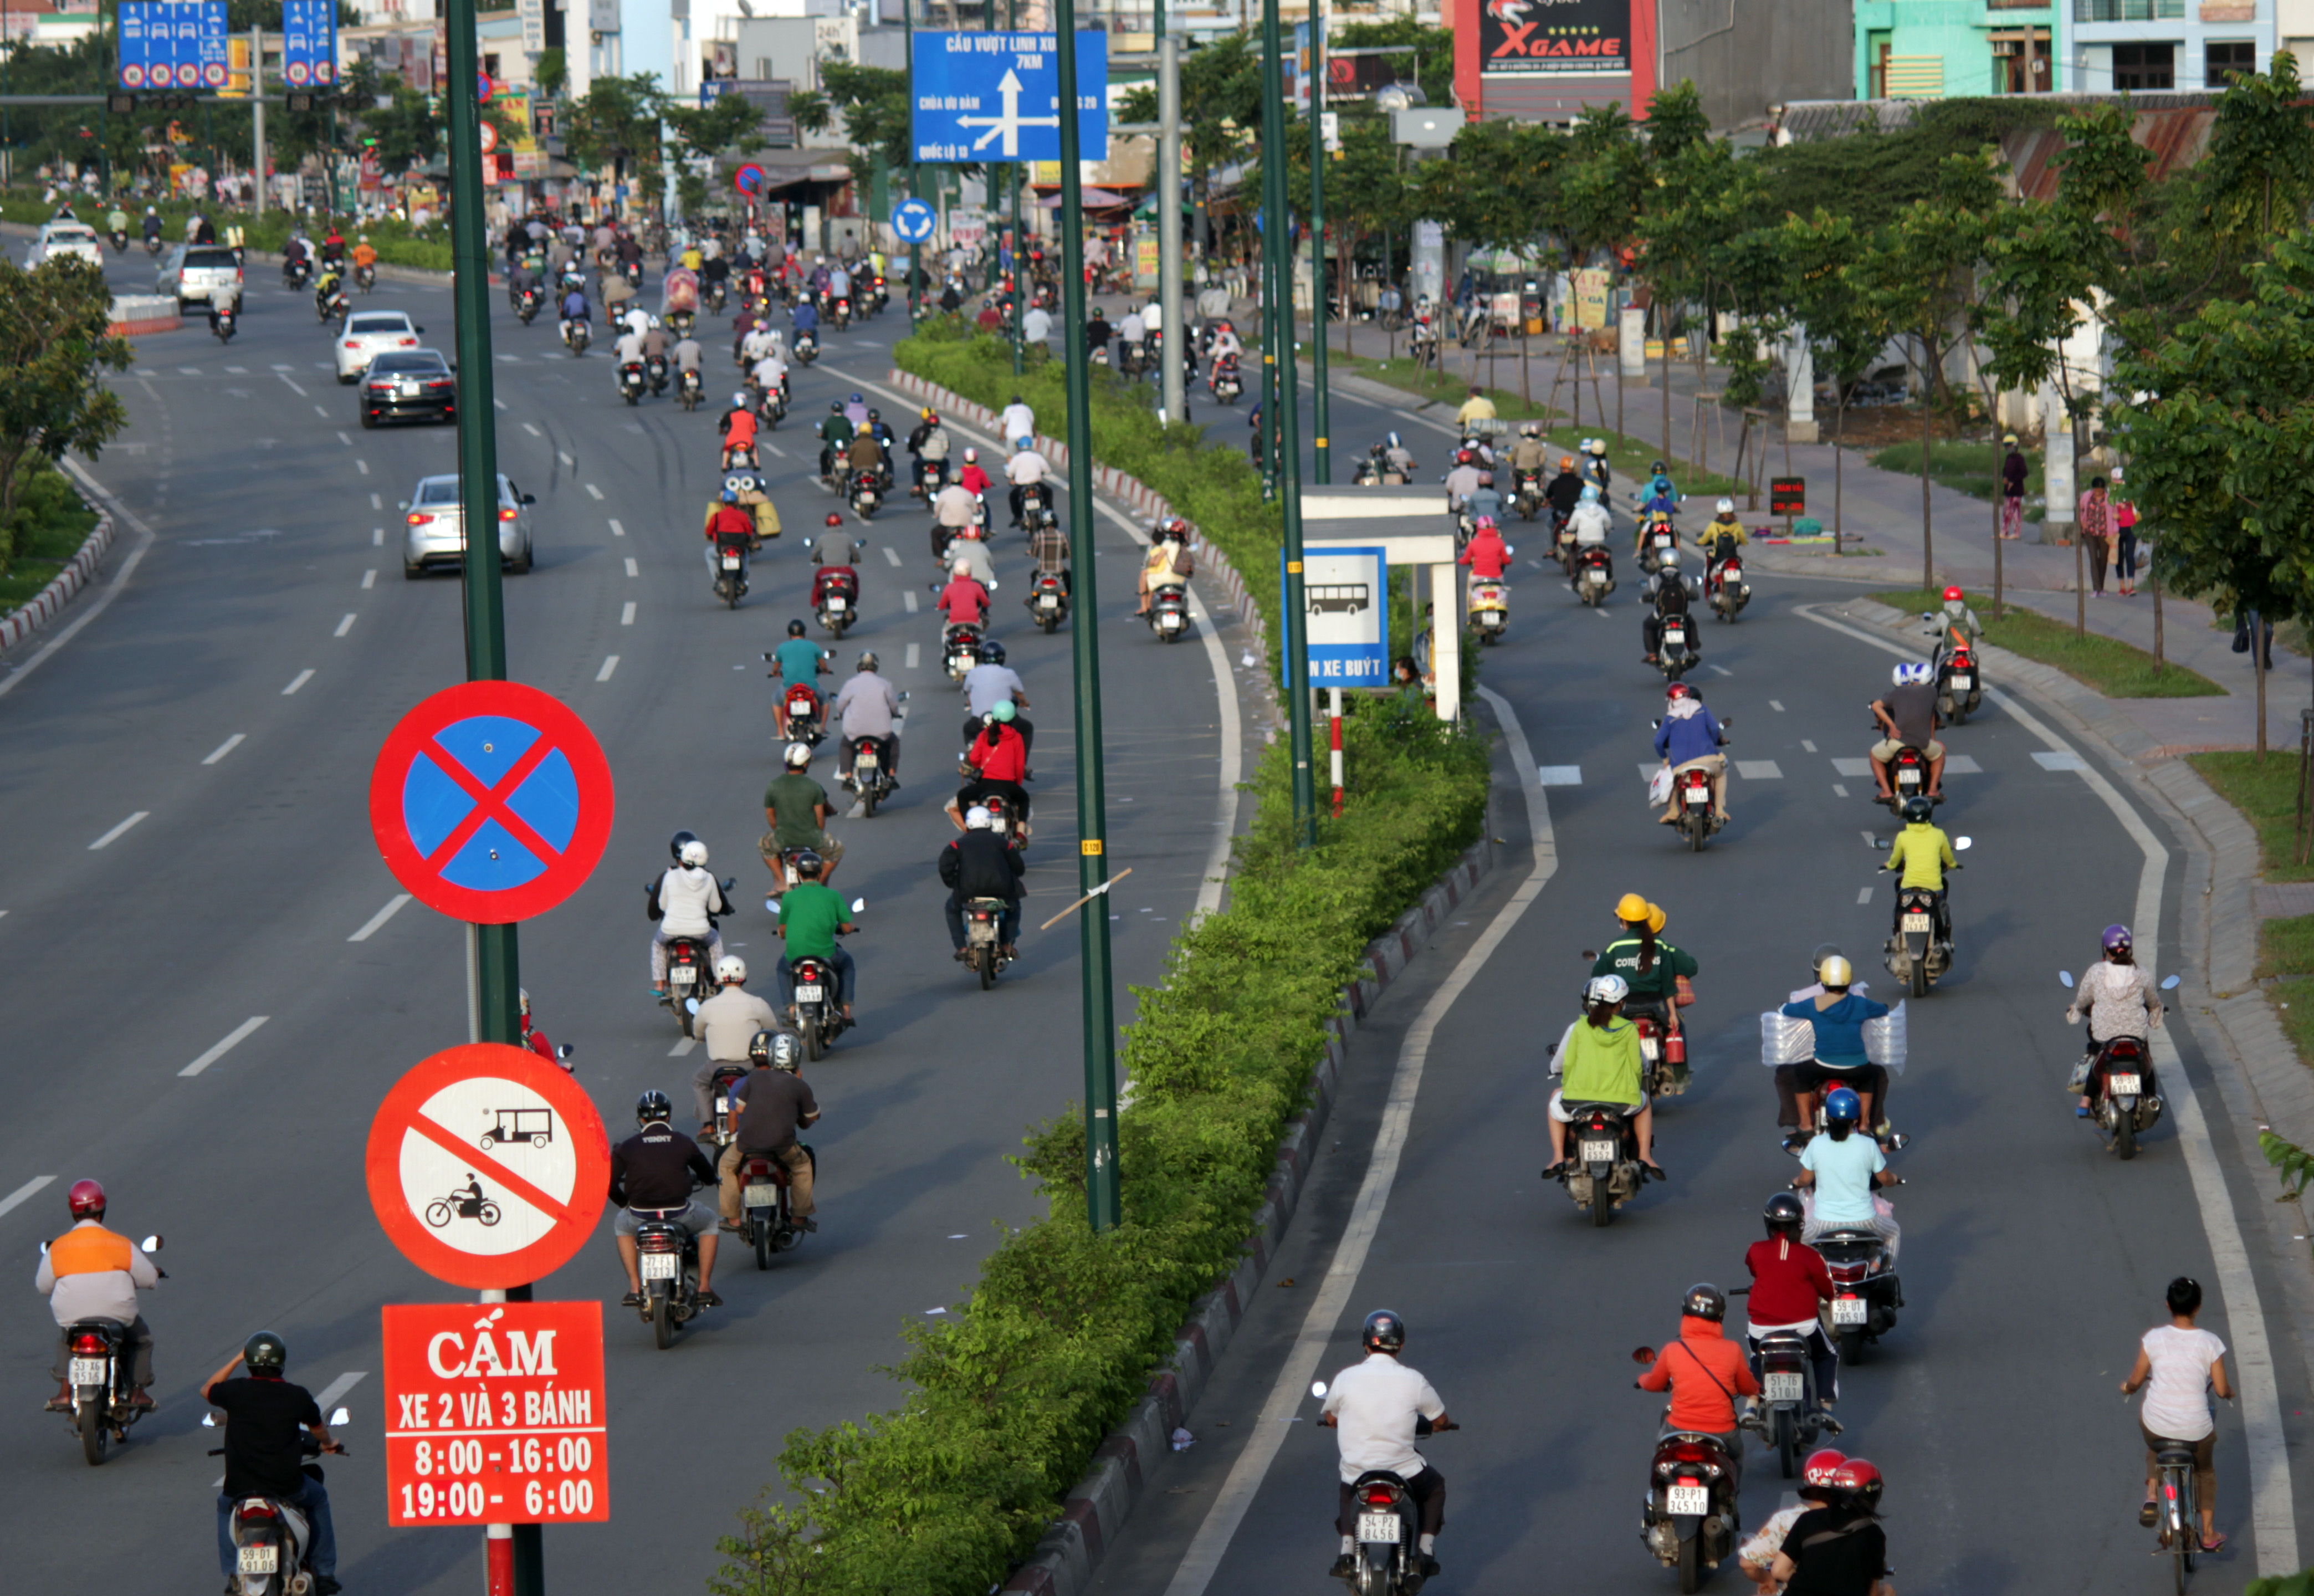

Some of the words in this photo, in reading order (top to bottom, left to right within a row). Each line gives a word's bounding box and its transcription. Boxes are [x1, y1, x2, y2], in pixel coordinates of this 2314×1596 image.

[975, 34, 1006, 55] VƯỢT
[1010, 37, 1037, 52] LINH
[1040, 37, 1057, 52] XU
[1016, 54, 1043, 69] 7KM
[1084, 96, 1097, 109] 20
[919, 141, 943, 159] QUỐC
[944, 142, 956, 160] LỘ
[958, 145, 968, 158] 13
[1323, 659, 1341, 677] XE
[1345, 656, 1381, 676] BUÝT
[1837, 1301, 1860, 1311] 59-U1
[1834, 1312, 1865, 1323] 785.90
[427, 1308, 557, 1379] CẤM
[1771, 1387, 1797, 1398] 5101
[399, 1394, 429, 1429] XE
[438, 1393, 453, 1428] 2
[460, 1383, 493, 1427] VÀ
[501, 1392, 516, 1426] 3
[525, 1381, 591, 1425] BÁNH
[415, 1440, 483, 1476] 8:00
[509, 1437, 592, 1473] 16:00
[402, 1482, 484, 1518] 19:00
[525, 1480, 593, 1516] 6:00
[1674, 1488, 1701, 1500] 93-P1
[1670, 1501, 1706, 1512] 345.10
[1365, 1516, 1394, 1527] 54-P2
[1365, 1528, 1394, 1540] 8456
[243, 1547, 270, 1559] 59-D1
[239, 1561, 275, 1573] 491.06
